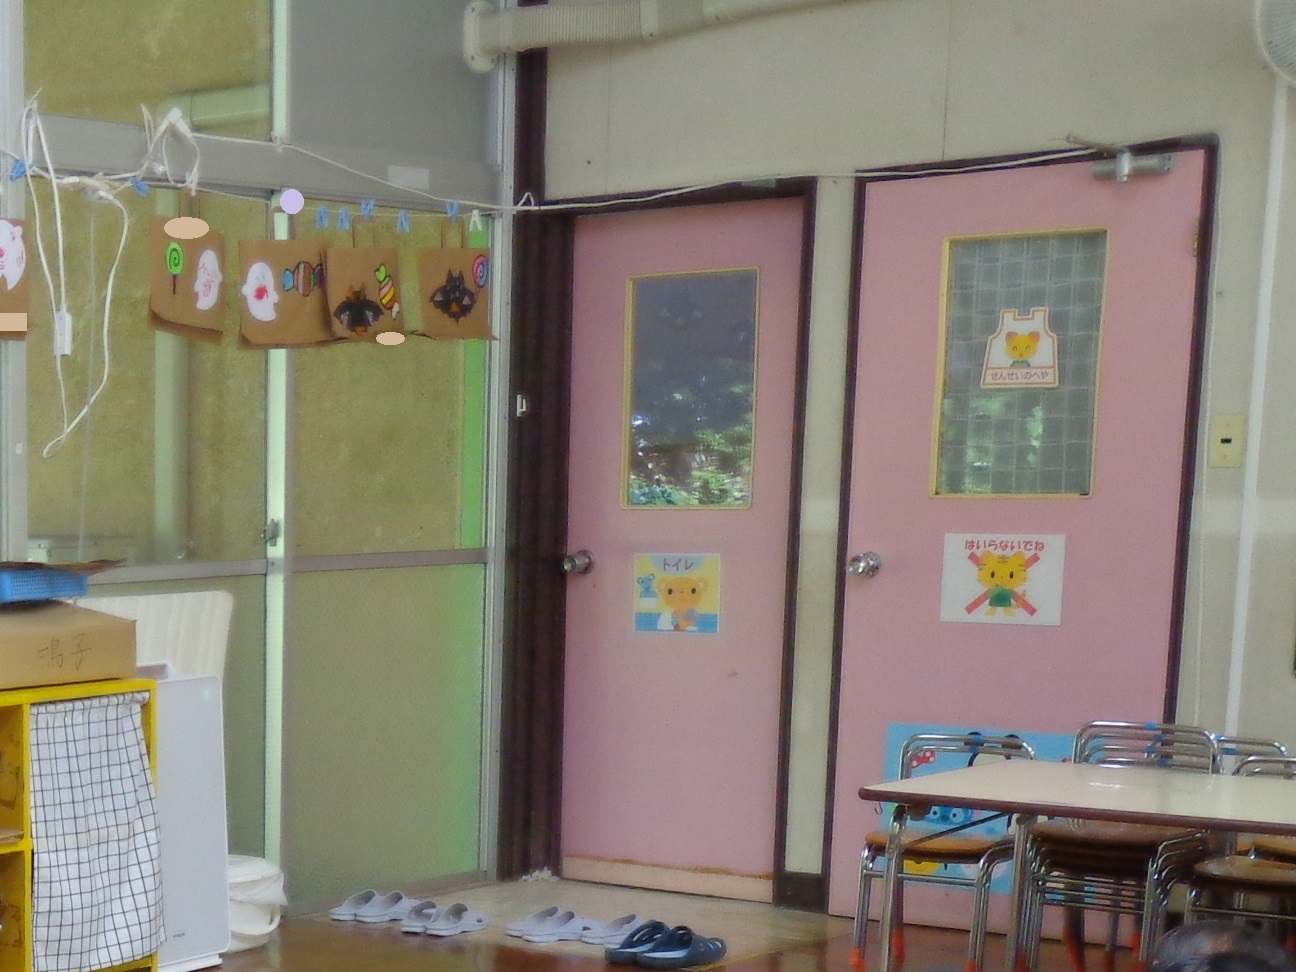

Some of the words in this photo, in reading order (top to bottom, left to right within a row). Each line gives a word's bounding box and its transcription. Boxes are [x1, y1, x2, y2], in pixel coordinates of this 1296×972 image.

[990, 371, 1049, 381] せんせいのへや
[964, 539, 1045, 552] はいらないでね
[663, 558, 694, 571] トイレ
